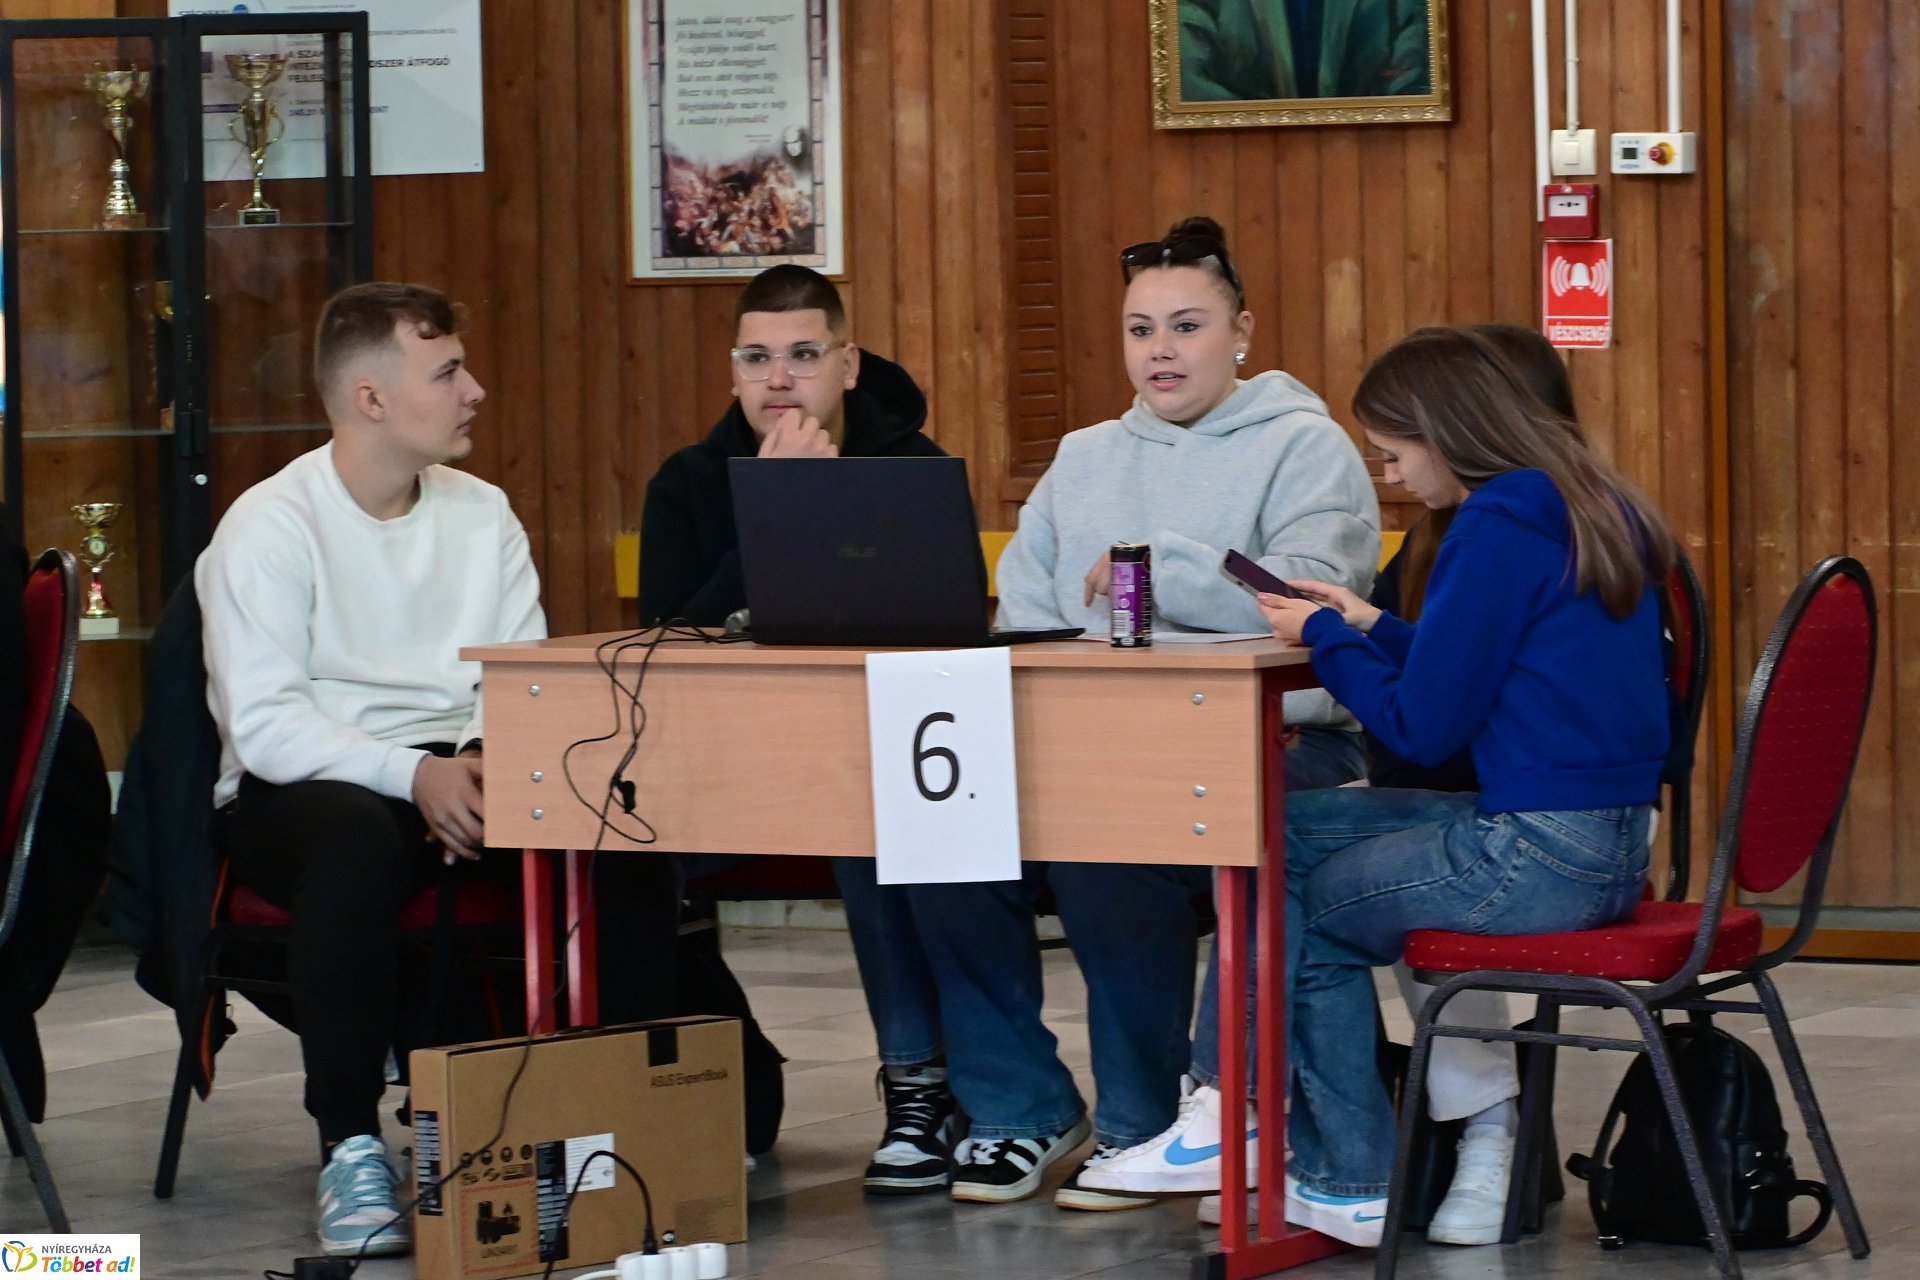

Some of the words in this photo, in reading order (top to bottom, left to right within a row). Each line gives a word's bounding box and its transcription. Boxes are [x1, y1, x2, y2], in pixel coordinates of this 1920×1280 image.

[407, 55, 452, 66] ÁTFOGÓ
[913, 711, 976, 802] 6.
[650, 1073, 675, 1088] ASUS
[676, 1068, 729, 1086] ExpertBook
